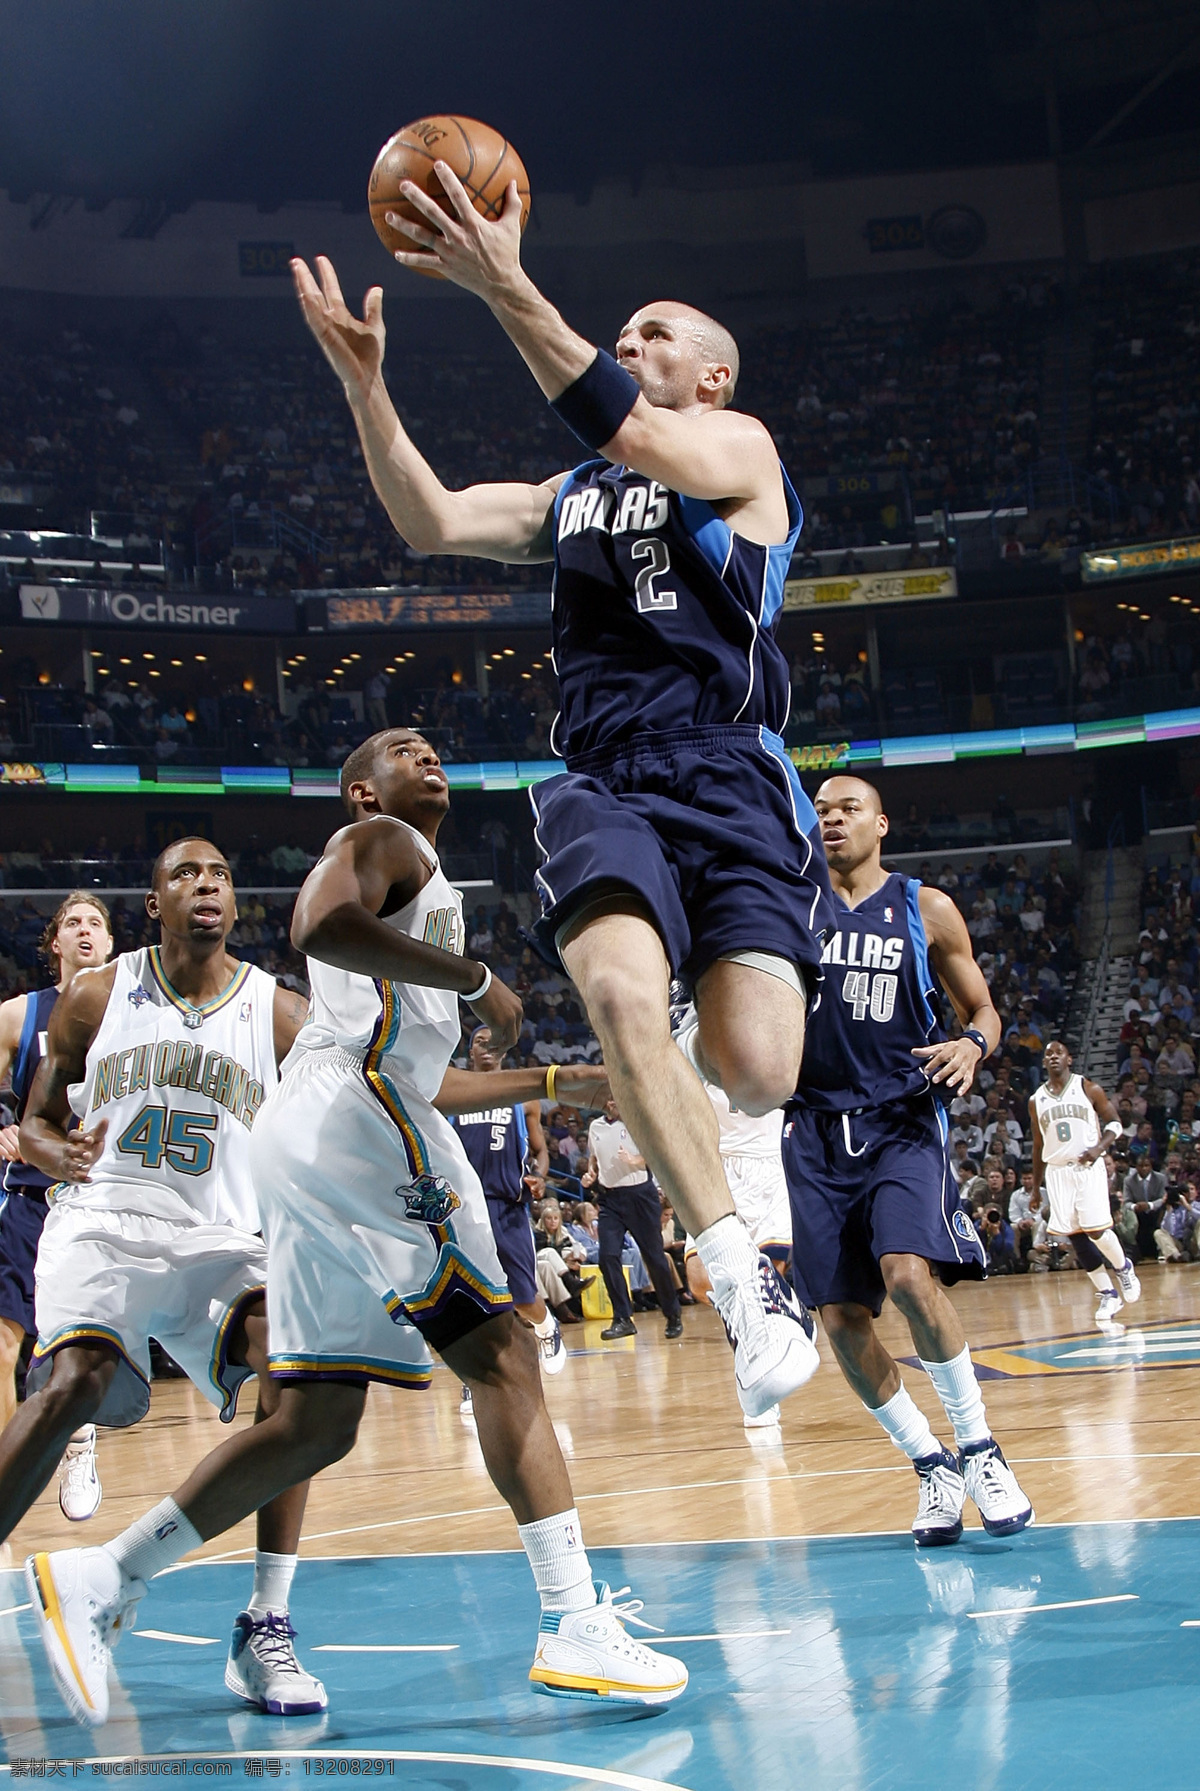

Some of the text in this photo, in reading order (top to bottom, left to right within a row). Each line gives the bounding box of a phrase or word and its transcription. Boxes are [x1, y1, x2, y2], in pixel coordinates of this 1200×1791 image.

[837, 477, 870, 492] 306
[631, 537, 678, 613] 2
[111, 593, 240, 626] Ochsner
[842, 971, 898, 1023] 40
[92, 1040, 263, 1132] NEW ORLEANS
[117, 1105, 218, 1176] 45
[490, 1124, 507, 1151] 5
[1056, 1121, 1072, 1143] 8
